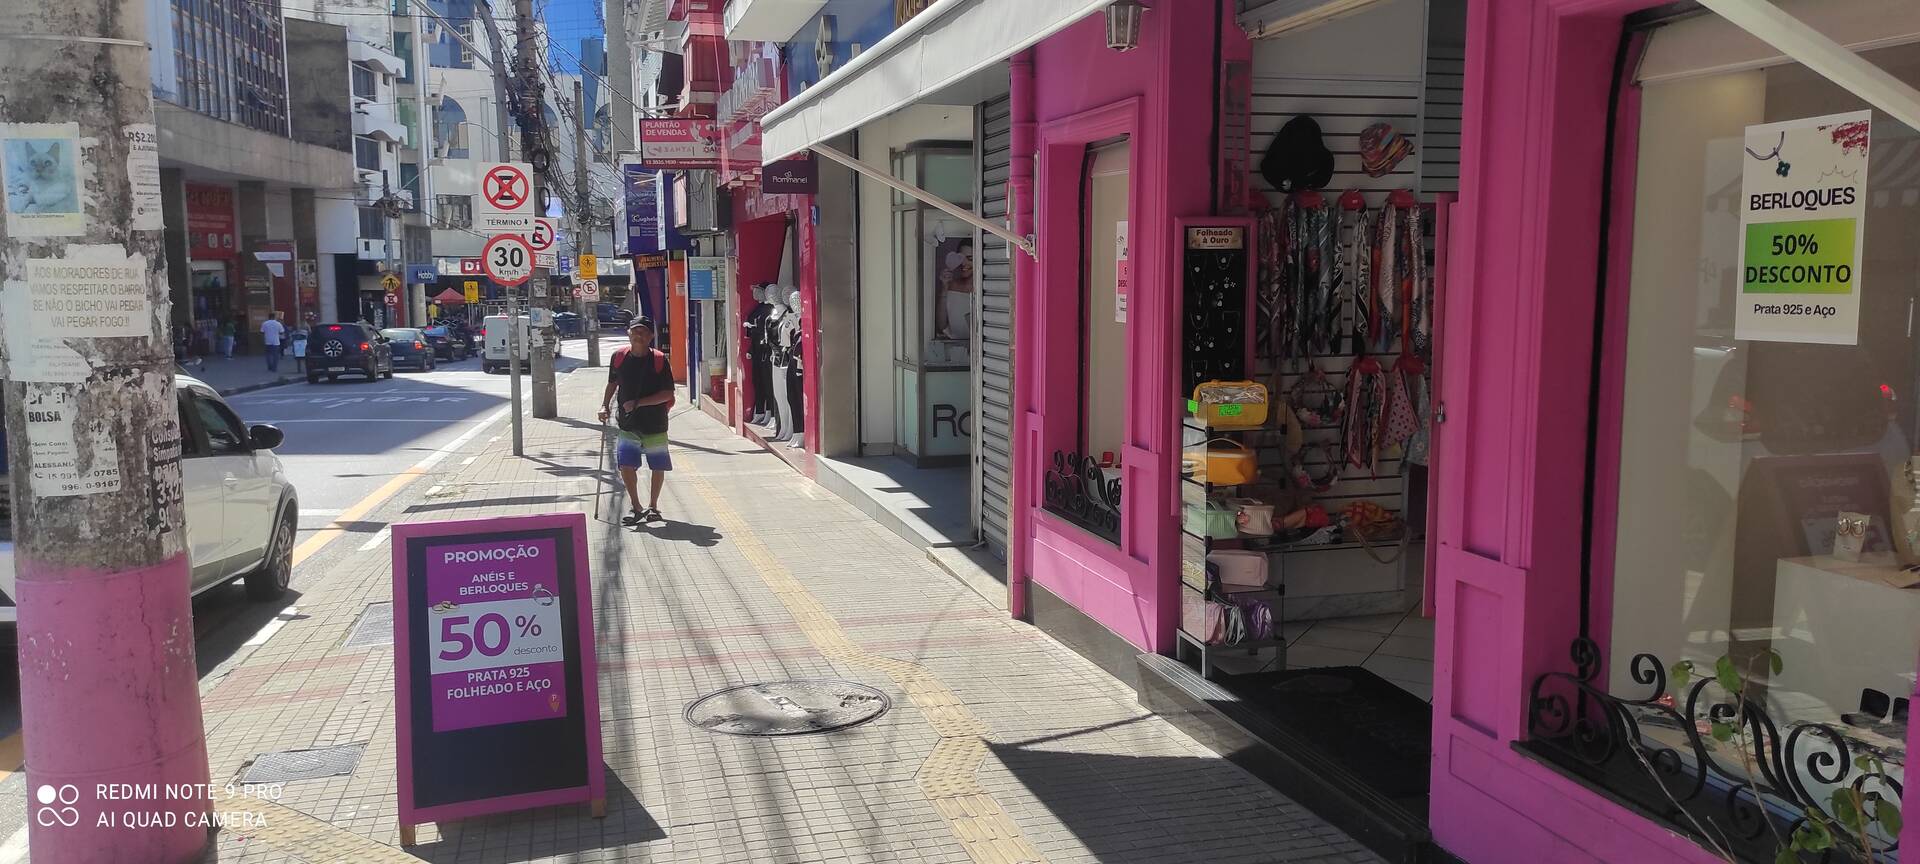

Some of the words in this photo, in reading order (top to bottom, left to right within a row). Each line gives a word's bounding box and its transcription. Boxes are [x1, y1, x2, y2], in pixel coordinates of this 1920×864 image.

[645, 120, 680, 128] PLANTÃO
[1750, 187, 1856, 211] BERLOQUES
[1771, 233, 1819, 256] 50%
[494, 246, 524, 267] 30
[34, 266, 52, 279] AOS
[53, 266, 110, 279] MORADORES
[111, 267, 123, 279] DE
[124, 268, 139, 279] RUA
[499, 268, 519, 277] km/h
[1745, 264, 1851, 284] DESCONTO
[30, 283, 58, 295] VAMOS
[59, 283, 109, 295] RESPEITAR
[110, 284, 117, 295] O
[118, 284, 145, 295] BAIRRO
[33, 300, 43, 311] SE
[45, 299, 64, 311] NÃO
[66, 300, 73, 311] O
[75, 300, 103, 311] BICHO
[104, 300, 118, 311] VAI
[120, 300, 144, 312] PEGAR
[1754, 304, 1781, 316] Prata
[1783, 303, 1803, 316] 925
[1804, 306, 1812, 316] e
[1813, 304, 1836, 318] Aço
[51, 316, 65, 328] VAI
[66, 316, 98, 328] PEGAR
[28, 411, 62, 423] BOLSA
[444, 544, 540, 564] PROMOÇÃO
[471, 571, 506, 584] ANÉIS
[509, 571, 516, 581] E
[459, 582, 529, 596] BERLOQUES
[514, 644, 558, 656] desconto
[467, 669, 507, 684] PRATA
[509, 667, 530, 679] 925
[447, 681, 514, 700] FOLHEADO
[516, 681, 524, 692] E
[525, 678, 551, 692] AÇO
